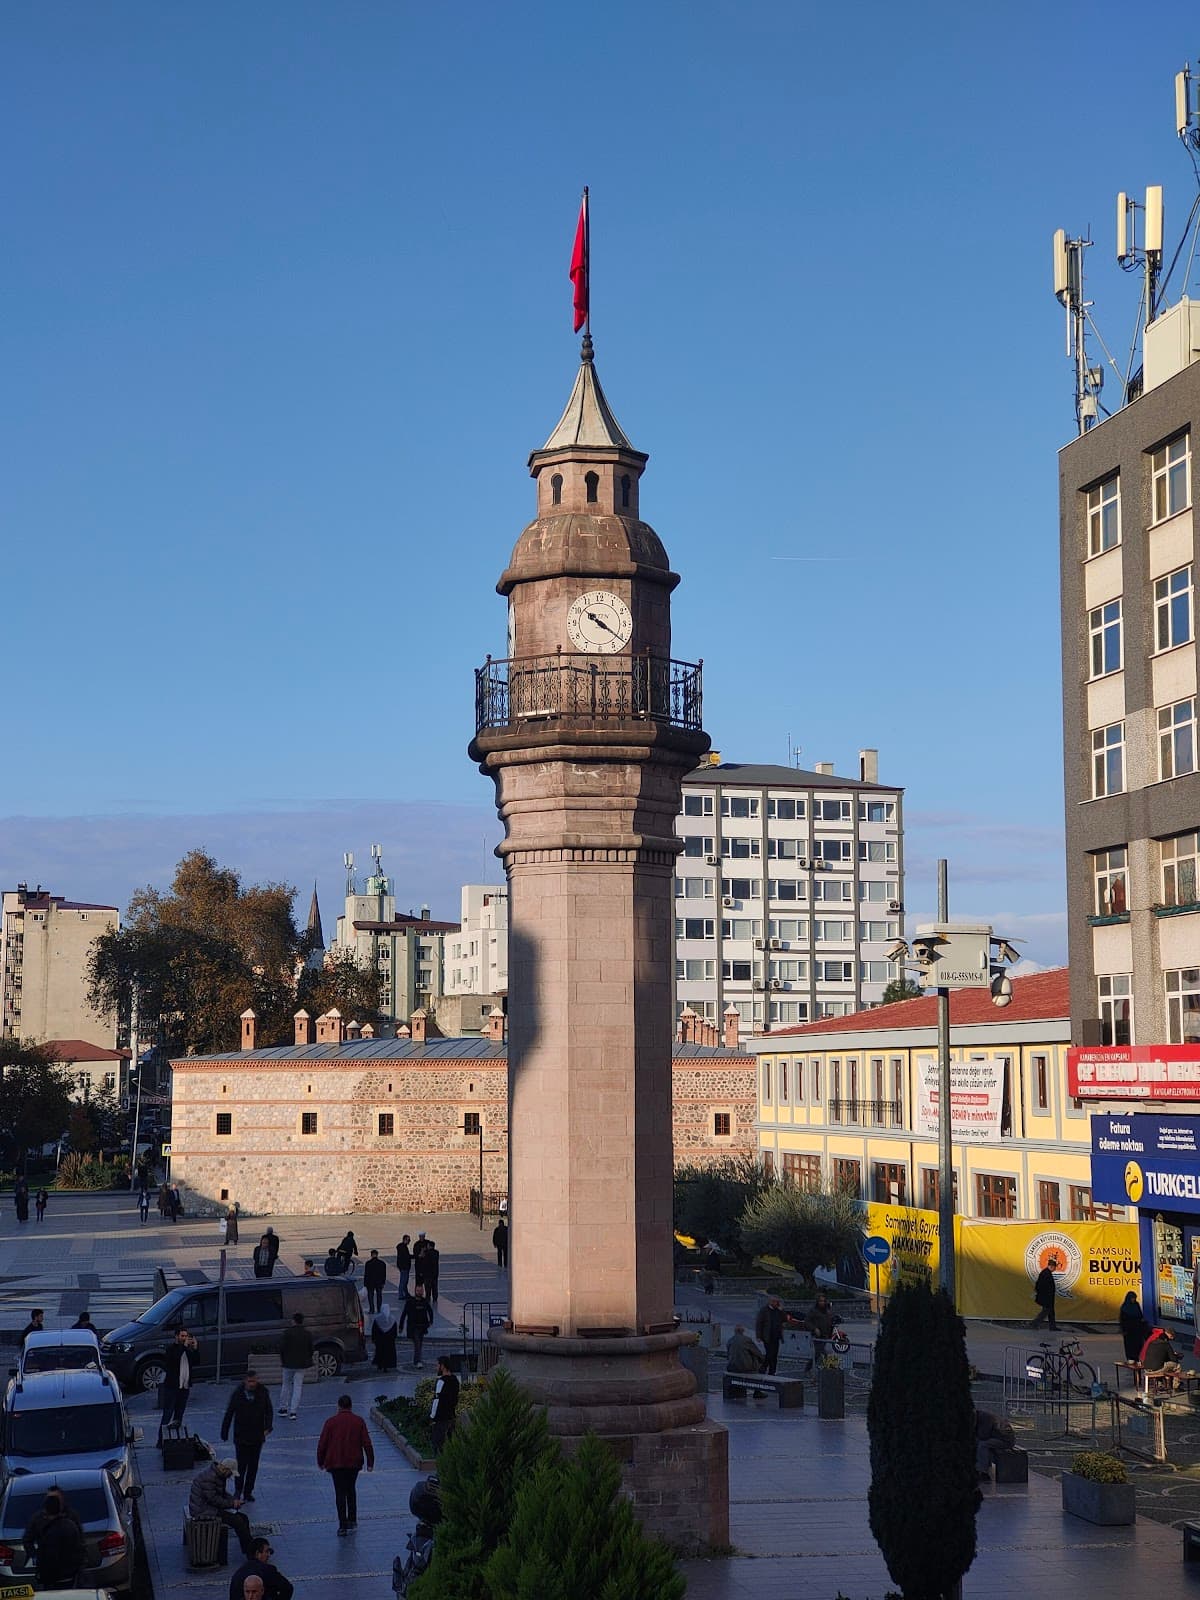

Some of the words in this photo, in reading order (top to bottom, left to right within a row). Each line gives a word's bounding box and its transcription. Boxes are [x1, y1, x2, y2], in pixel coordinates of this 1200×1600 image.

[1110, 1121, 1131, 1134] Fatura
[1099, 1137, 1121, 1150] ödeme
[1121, 1138, 1144, 1152] noktası
[1146, 1171, 1200, 1199] TURKCEL
[1089, 1247, 1132, 1256] SAMSUN
[1089, 1257, 1141, 1274] BÜYÜK
